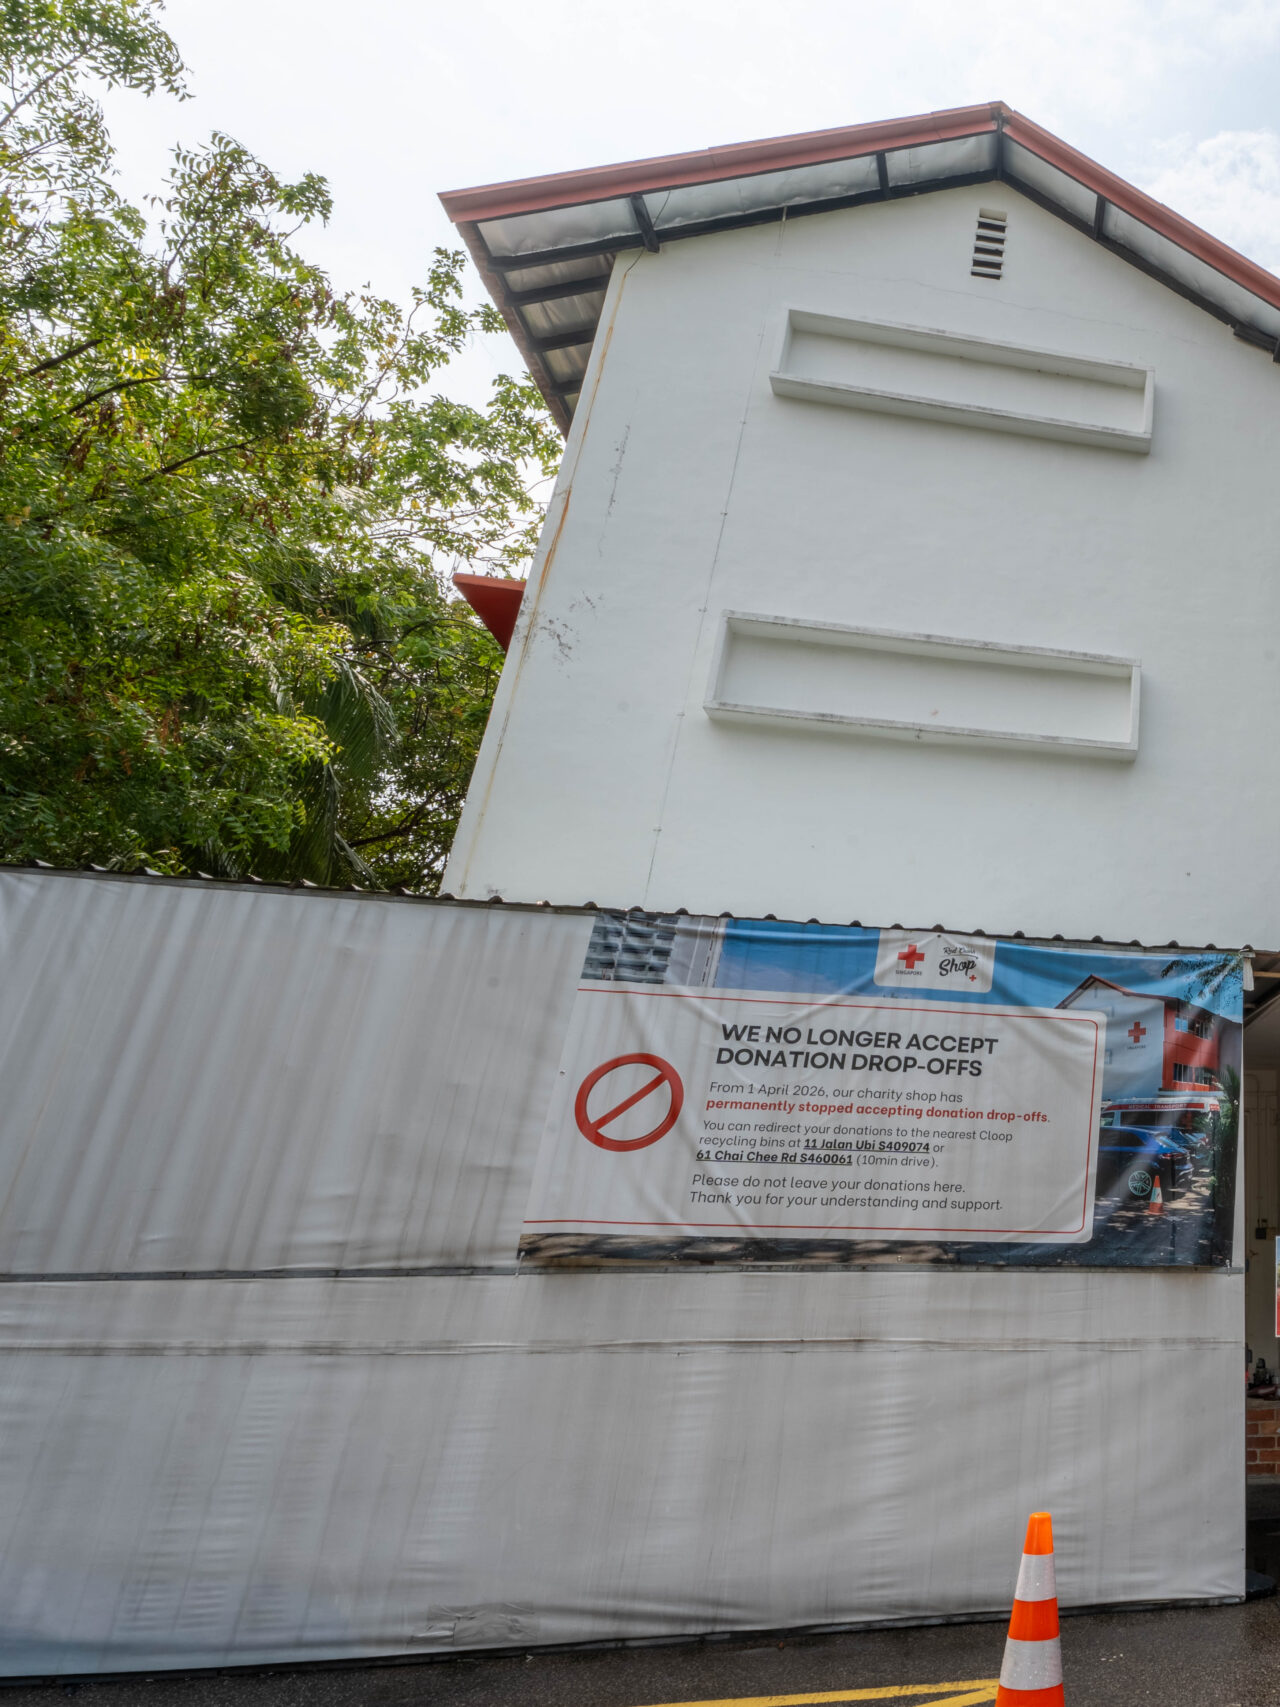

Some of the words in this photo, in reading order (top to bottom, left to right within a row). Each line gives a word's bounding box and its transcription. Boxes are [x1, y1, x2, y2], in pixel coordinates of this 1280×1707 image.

[943, 946, 958, 955] Red
[938, 957, 977, 977] Shop
[721, 1023, 761, 1043] WE
[765, 1026, 802, 1044] NO
[806, 1028, 902, 1049] LONGER
[905, 1033, 999, 1054] ACCEPT
[716, 1047, 847, 1070] DONATION
[851, 1054, 983, 1077] DROP-OFFS
[709, 1081, 745, 1094] From
[748, 1083, 755, 1094] 1
[758, 1083, 790, 1097] April
[792, 1085, 829, 1098] 2026,
[832, 1088, 855, 1098] our
[857, 1088, 903, 1102] charity
[905, 1090, 937, 1104] shop
[940, 1091, 963, 1103] has
[706, 1099, 796, 1114] permanently
[798, 1102, 854, 1116] stopped
[856, 1105, 923, 1119] accepting
[926, 1106, 984, 1119] donation
[986, 1109, 1050, 1123] drop-offs.
[703, 1120, 725, 1131] You
[727, 1122, 751, 1132] can
[753, 1122, 802, 1134] redirect
[804, 1125, 831, 1136] your
[833, 1125, 893, 1137] donations
[896, 1127, 908, 1137] to
[911, 1127, 930, 1138] the
[933, 1129, 976, 1140] nearest
[979, 1130, 1013, 1142] Cloop
[699, 1135, 757, 1149] recycling
[759, 1136, 785, 1148] bins
[788, 1138, 801, 1148] at
[804, 1138, 818, 1149] 11
[820, 1139, 853, 1150] Jalan
[856, 1140, 876, 1150] Ubi
[878, 1141, 930, 1152] S409074
[933, 1143, 945, 1153] or
[696, 1150, 711, 1161] 61
[714, 1150, 744, 1162] Chai
[746, 1151, 778, 1162] Chee
[781, 1152, 797, 1162] Rd
[800, 1152, 853, 1165] S460061
[856, 1154, 898, 1167] (10min
[901, 1155, 939, 1169] drive).
[692, 1174, 739, 1187] Please
[743, 1175, 760, 1188] do
[764, 1176, 787, 1188] not
[790, 1176, 828, 1189] leave
[831, 1179, 862, 1192] your
[864, 1178, 930, 1192] donations
[933, 1181, 966, 1193] here.
[690, 1191, 732, 1204] Thank
[735, 1195, 762, 1206] you
[765, 1192, 783, 1205] for
[786, 1196, 818, 1208] your
[820, 1195, 919, 1211] understanding
[922, 1197, 948, 1209] and
[950, 1198, 1003, 1212] support.
